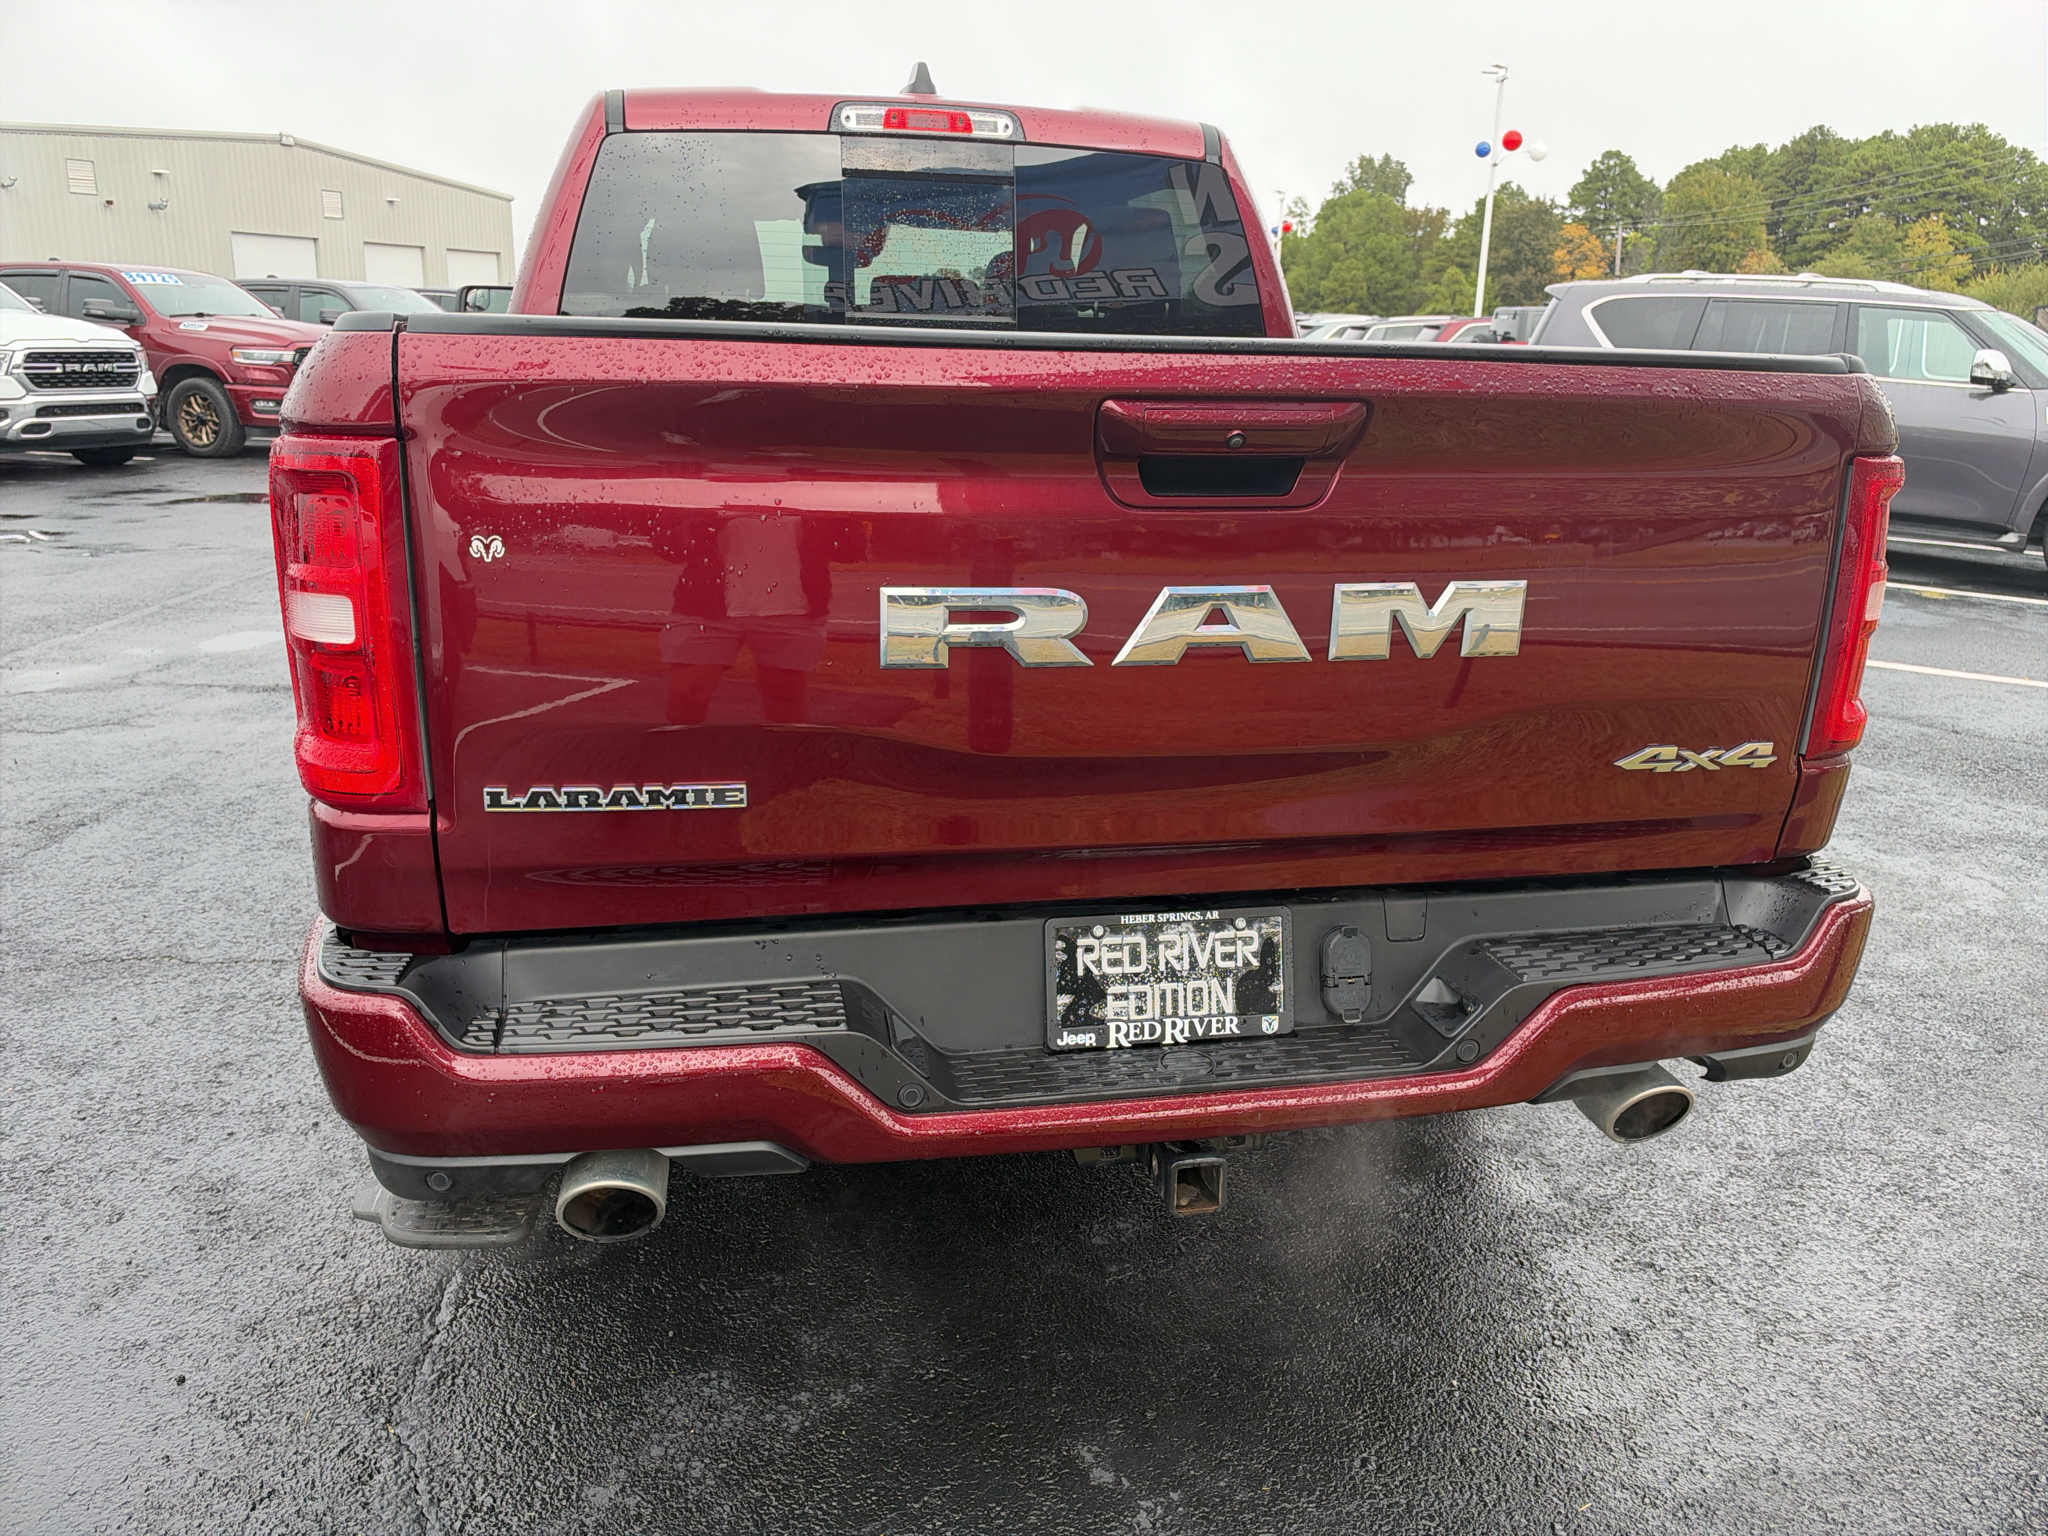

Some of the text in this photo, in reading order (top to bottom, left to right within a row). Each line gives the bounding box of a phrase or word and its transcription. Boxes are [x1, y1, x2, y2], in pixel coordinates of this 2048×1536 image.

[124, 271, 179, 284] 39725
[64, 363, 116, 373] RAM
[879, 578, 1528, 669] RAM
[483, 783, 748, 812] LARAMIE
[1120, 910, 1220, 925] HEBER SPRINGS, AR
[1076, 930, 1261, 976] RED RIVER
[1106, 977, 1234, 1021] EDITION
[1056, 1031, 1097, 1047] Jeep
